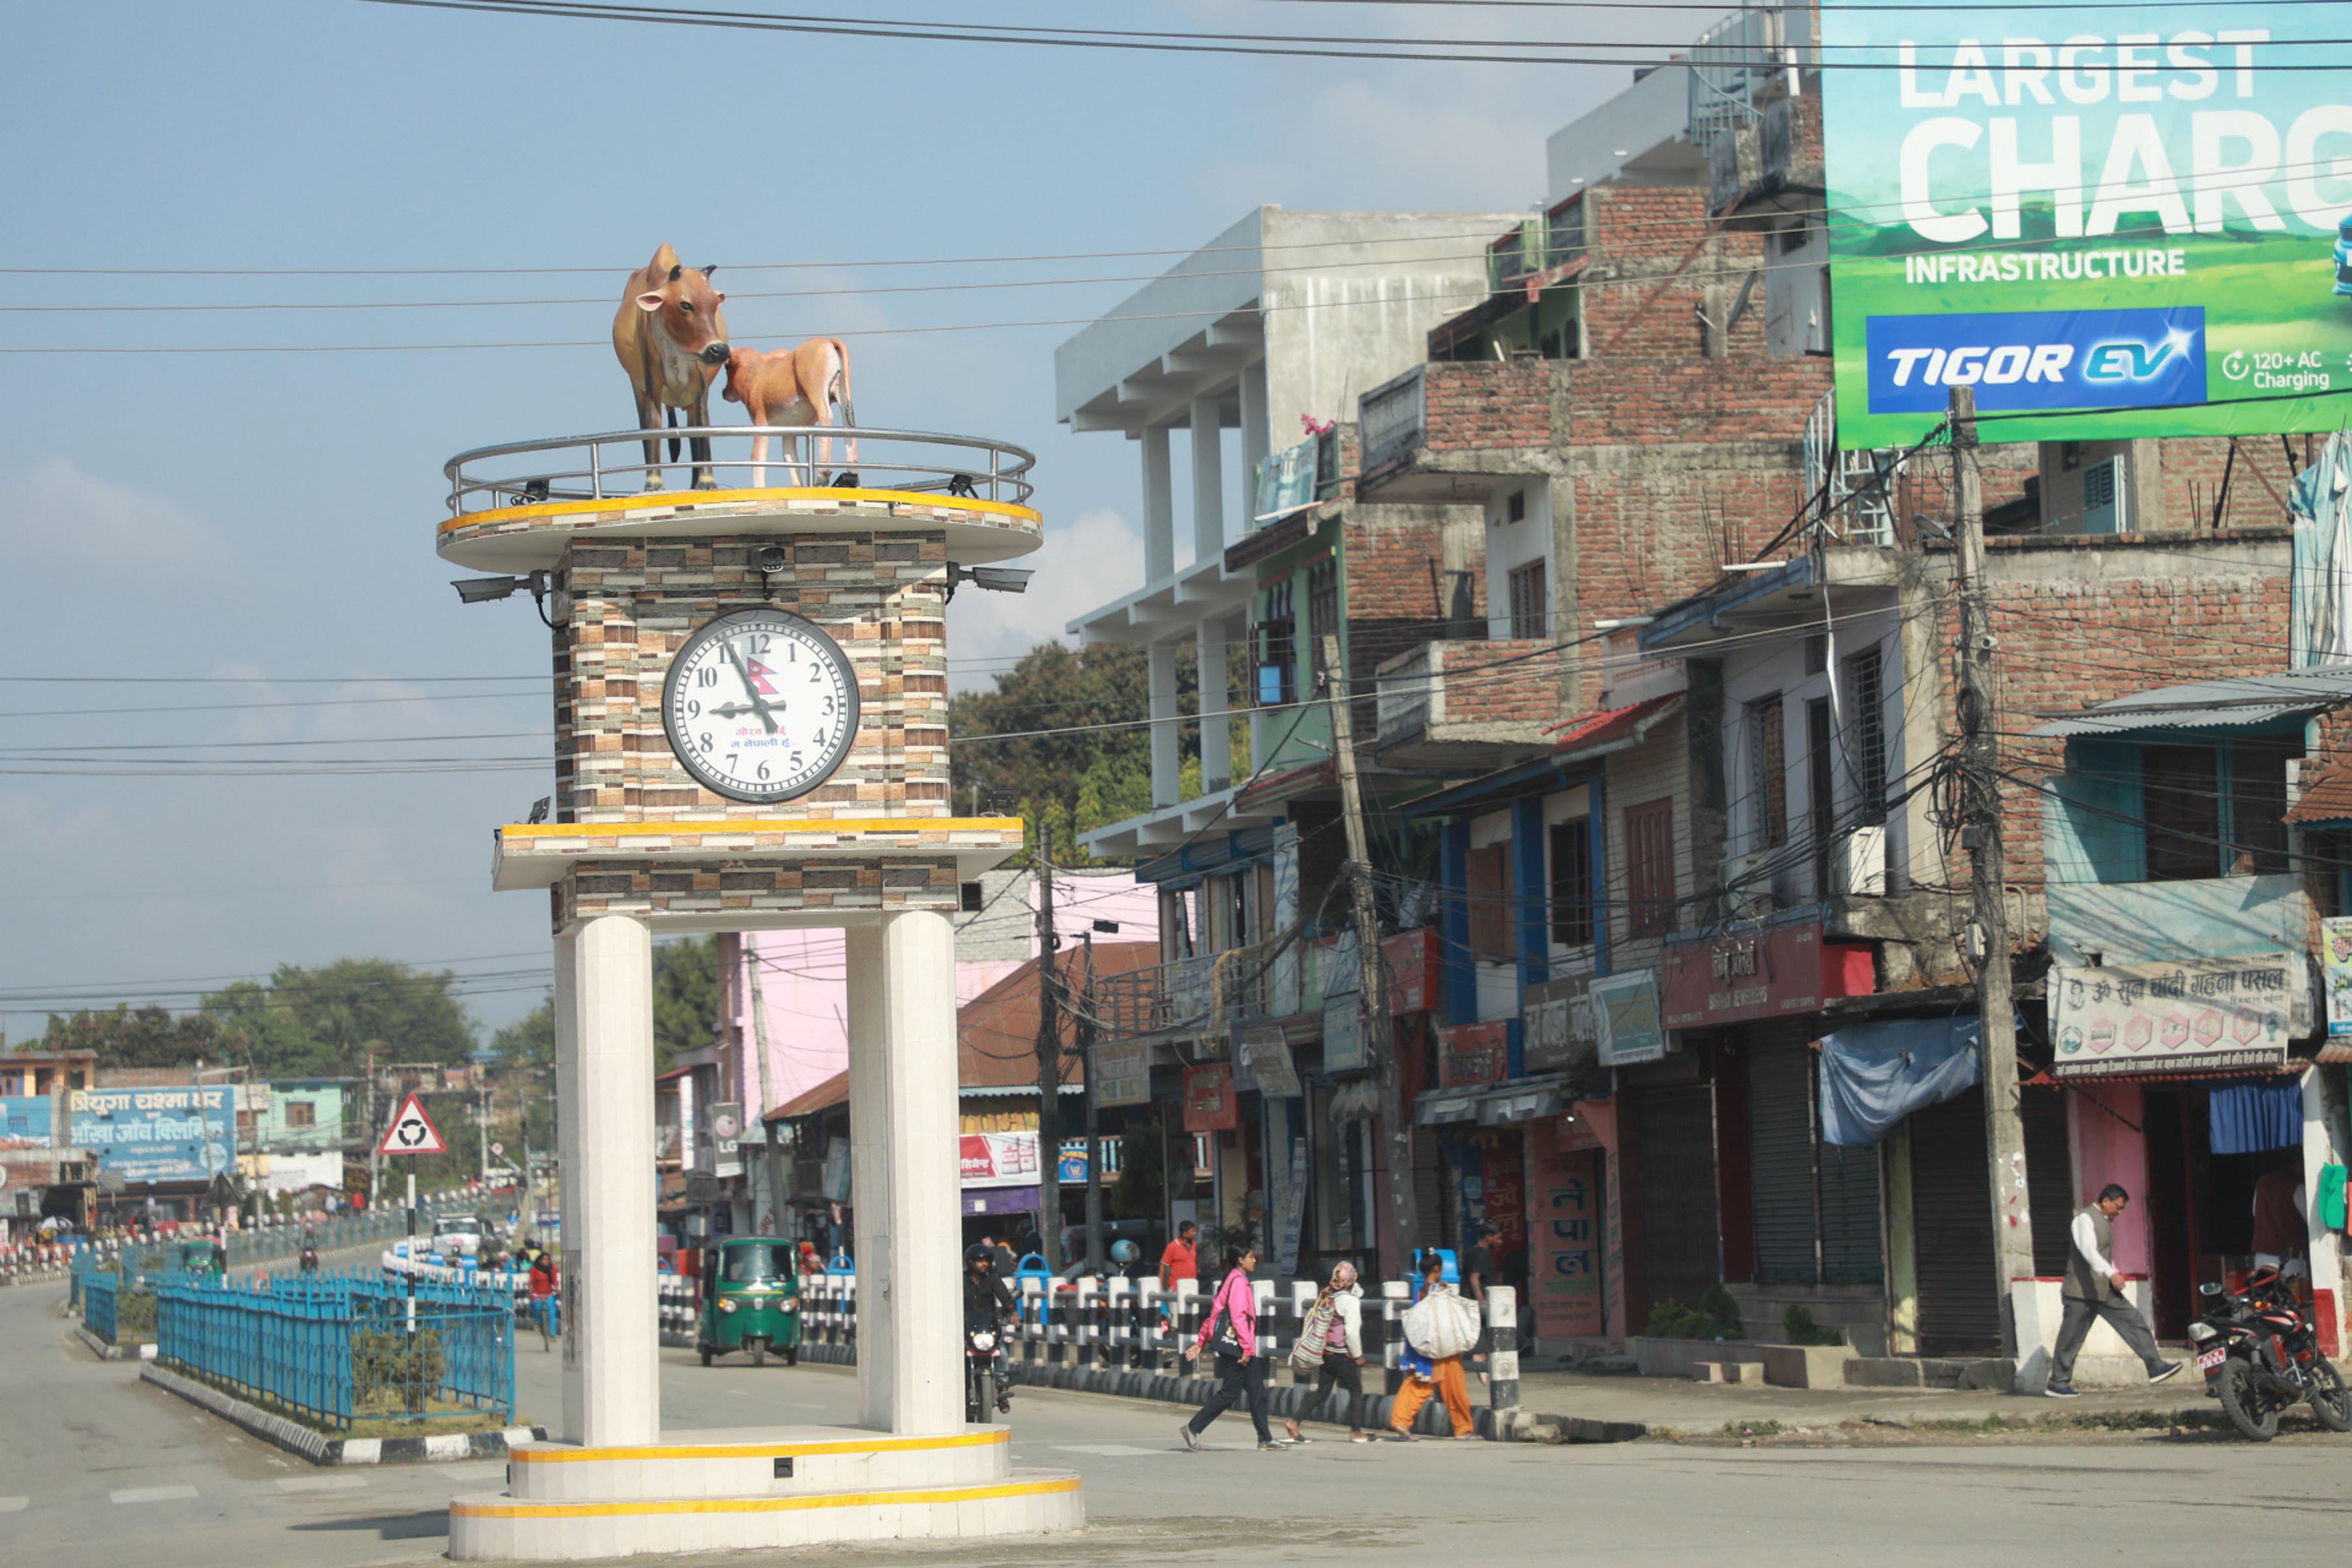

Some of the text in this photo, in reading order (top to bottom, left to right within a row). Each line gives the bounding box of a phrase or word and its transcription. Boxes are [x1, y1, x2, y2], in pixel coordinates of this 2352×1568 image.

[1899, 29, 2269, 108] LARGEST
[1906, 250, 2185, 283] INFRASTRUCTURE
[1887, 338, 2180, 386] TIGOR EV
[2253, 351, 2323, 370] 120+ AC
[2254, 370, 2330, 391] Charging
[749, 634, 772, 654] 12
[787, 642, 796, 662] 1
[696, 666, 717, 687] 10
[809, 662, 821, 683] 2
[688, 699, 700, 721] 9
[821, 695, 835, 716] 3
[700, 732, 713, 753] 8
[744, 738, 777, 747] नेपाली
[813, 727, 826, 747] 4
[726, 753, 738, 774] 7
[757, 759, 770, 781] 6
[790, 751, 802, 771] 5
[2117, 978, 2146, 1007] सुन
[2191, 970, 2237, 996] गहना
[2241, 968, 2285, 991] पसल
[719, 1139, 738, 1153] LG
